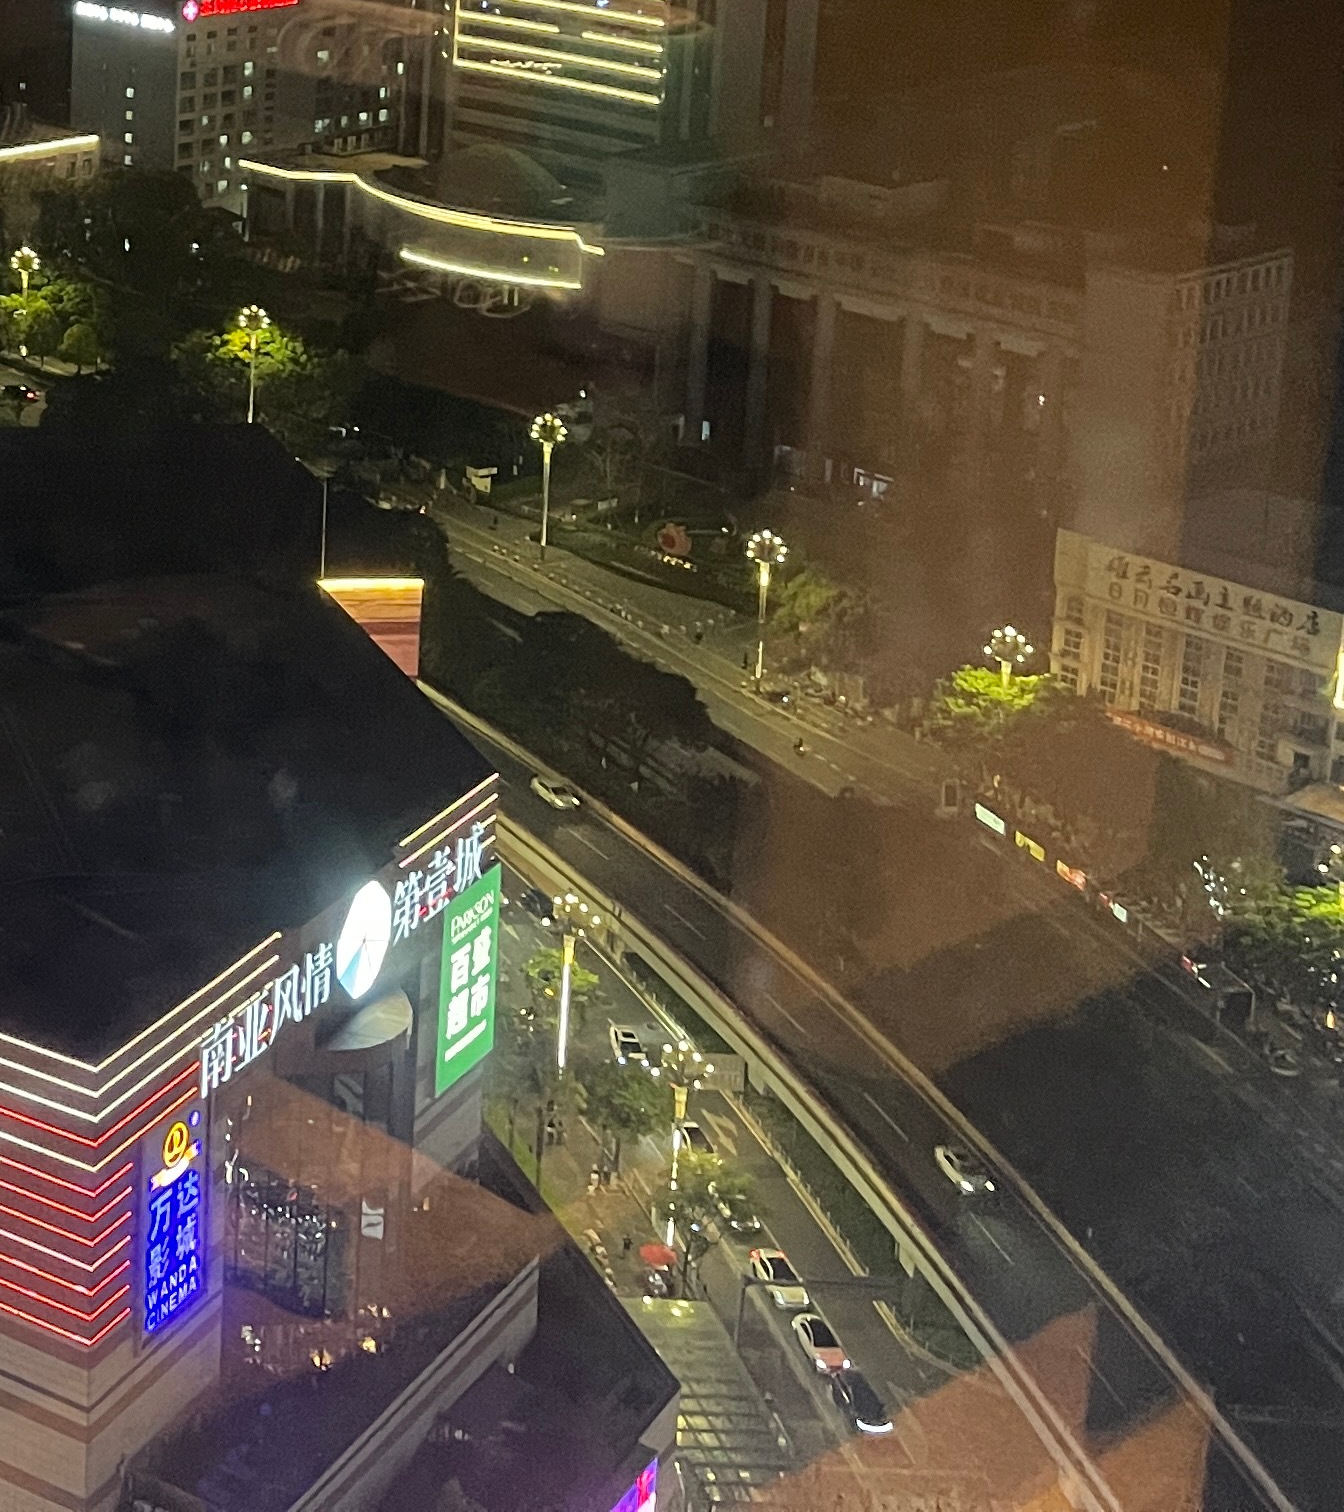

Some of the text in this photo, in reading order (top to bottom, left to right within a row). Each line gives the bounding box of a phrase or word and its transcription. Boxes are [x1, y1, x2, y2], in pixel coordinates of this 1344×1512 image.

[451, 890, 494, 938] PARKSON
[201, 822, 484, 1099] 南亚风情 第壹城
[150, 1170, 199, 1241] 万达
[147, 1255, 197, 1310] WANDA
[148, 1213, 196, 1289] 影城
[146, 1276, 197, 1331] CINEMA
